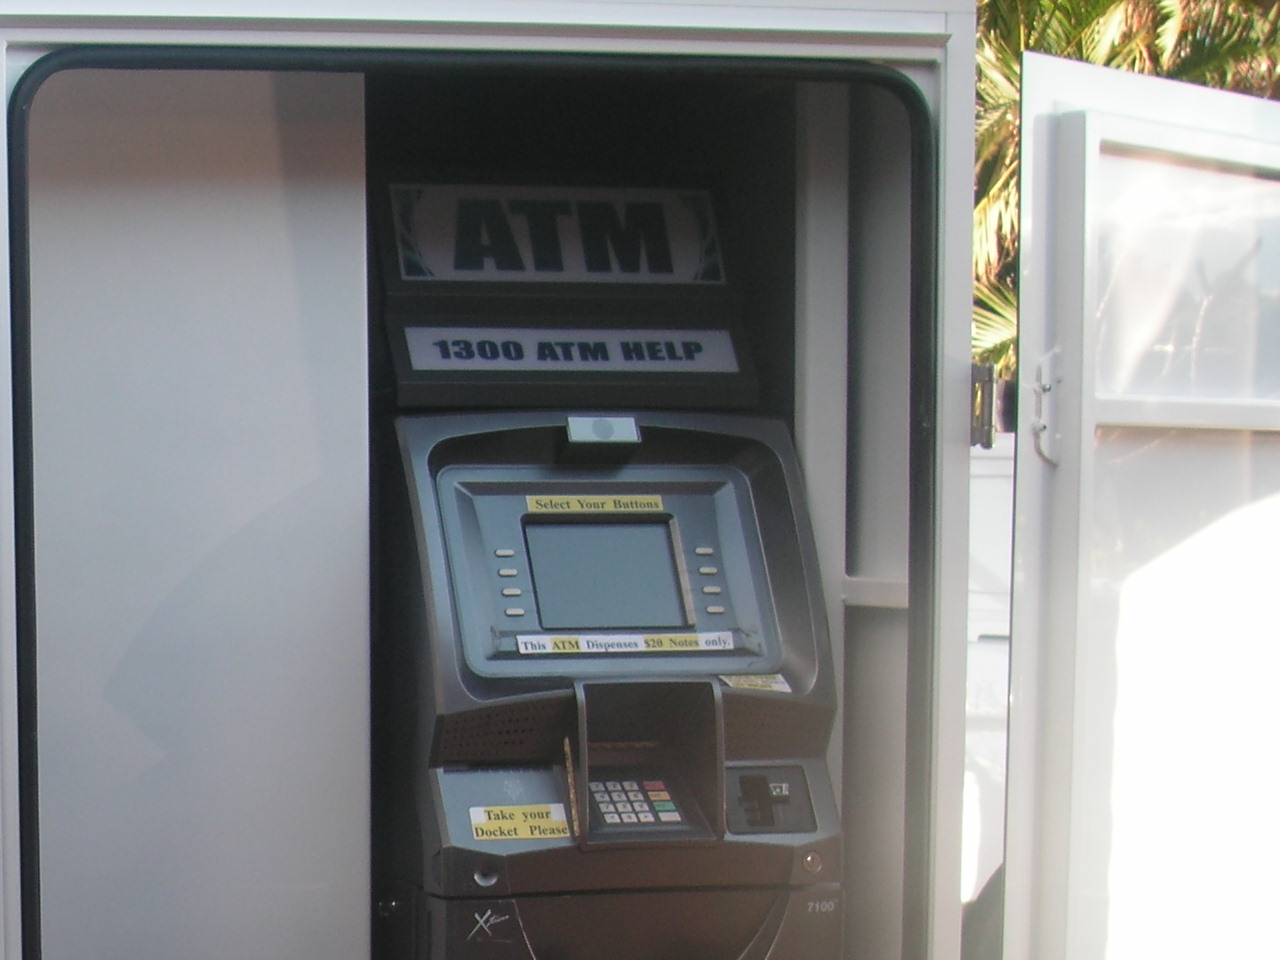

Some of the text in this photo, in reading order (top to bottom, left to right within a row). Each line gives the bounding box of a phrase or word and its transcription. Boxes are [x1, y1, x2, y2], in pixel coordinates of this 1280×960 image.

[454, 199, 674, 274] ATM
[433, 339, 703, 362] 1300 ATM HELP
[535, 499, 659, 510] Select Your Buttons
[521, 636, 731, 652] This ATM Dispenses $20 Notes only.
[484, 810, 551, 822] Take your
[475, 824, 569, 838] Docket Please
[808, 900, 835, 912] 7100
